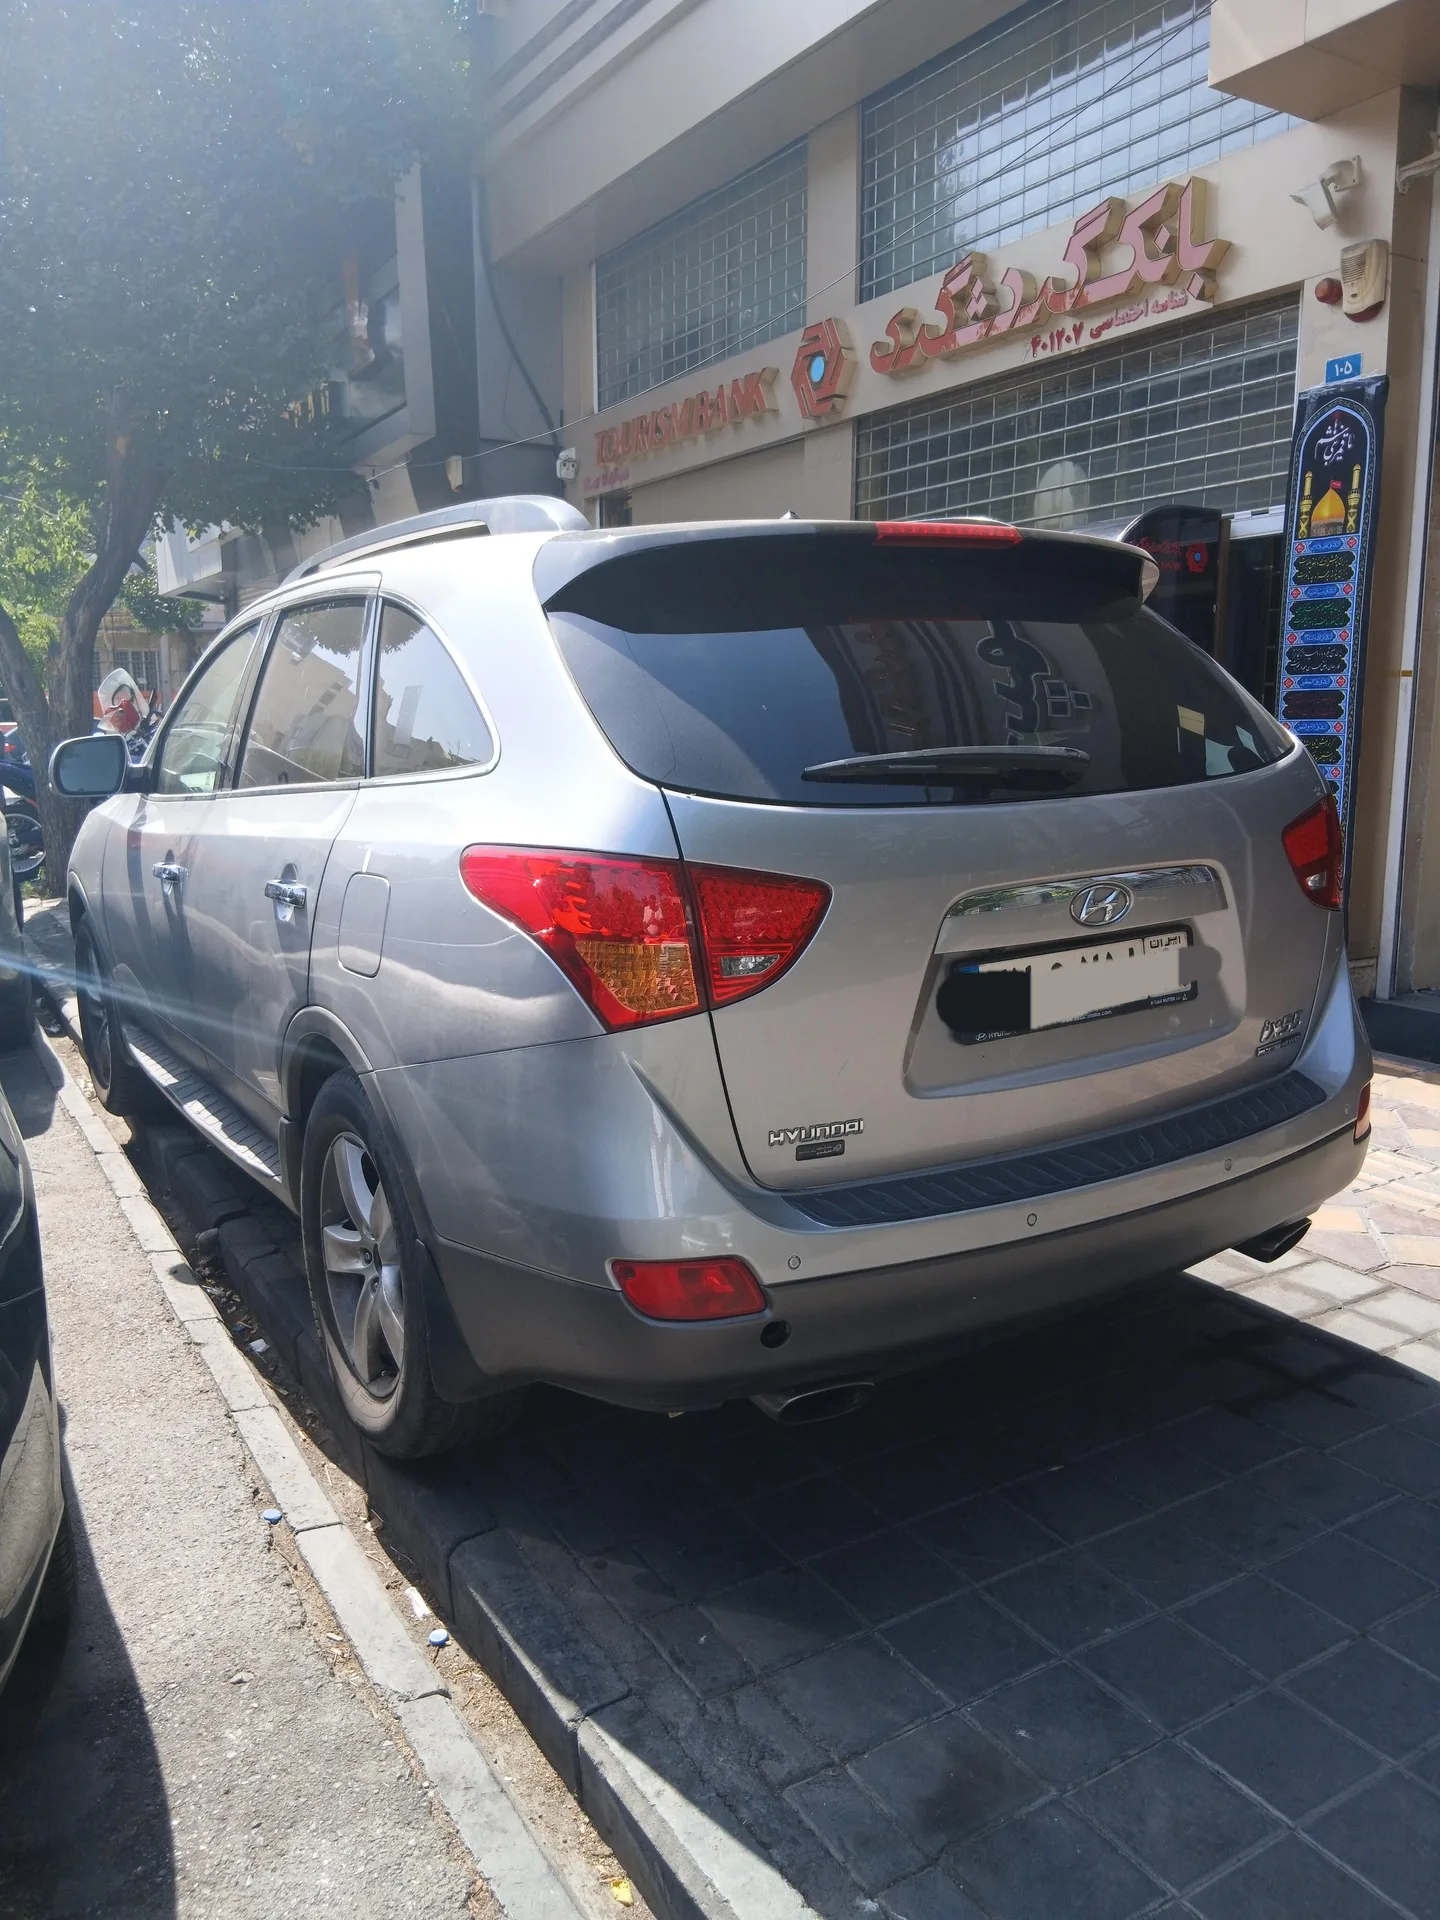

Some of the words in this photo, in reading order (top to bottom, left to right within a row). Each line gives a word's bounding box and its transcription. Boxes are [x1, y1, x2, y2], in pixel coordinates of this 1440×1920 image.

[1073, 176, 1226, 308] بانک
[869, 196, 1122, 375] گردشگری
[1334, 360, 1353, 377] ۱۰۵
[595, 397, 696, 467] TOURISM
[693, 368, 775, 434] BANK
[1149, 935, 1181, 949] ایران
[768, 1117, 864, 1147] HYUNDAI
